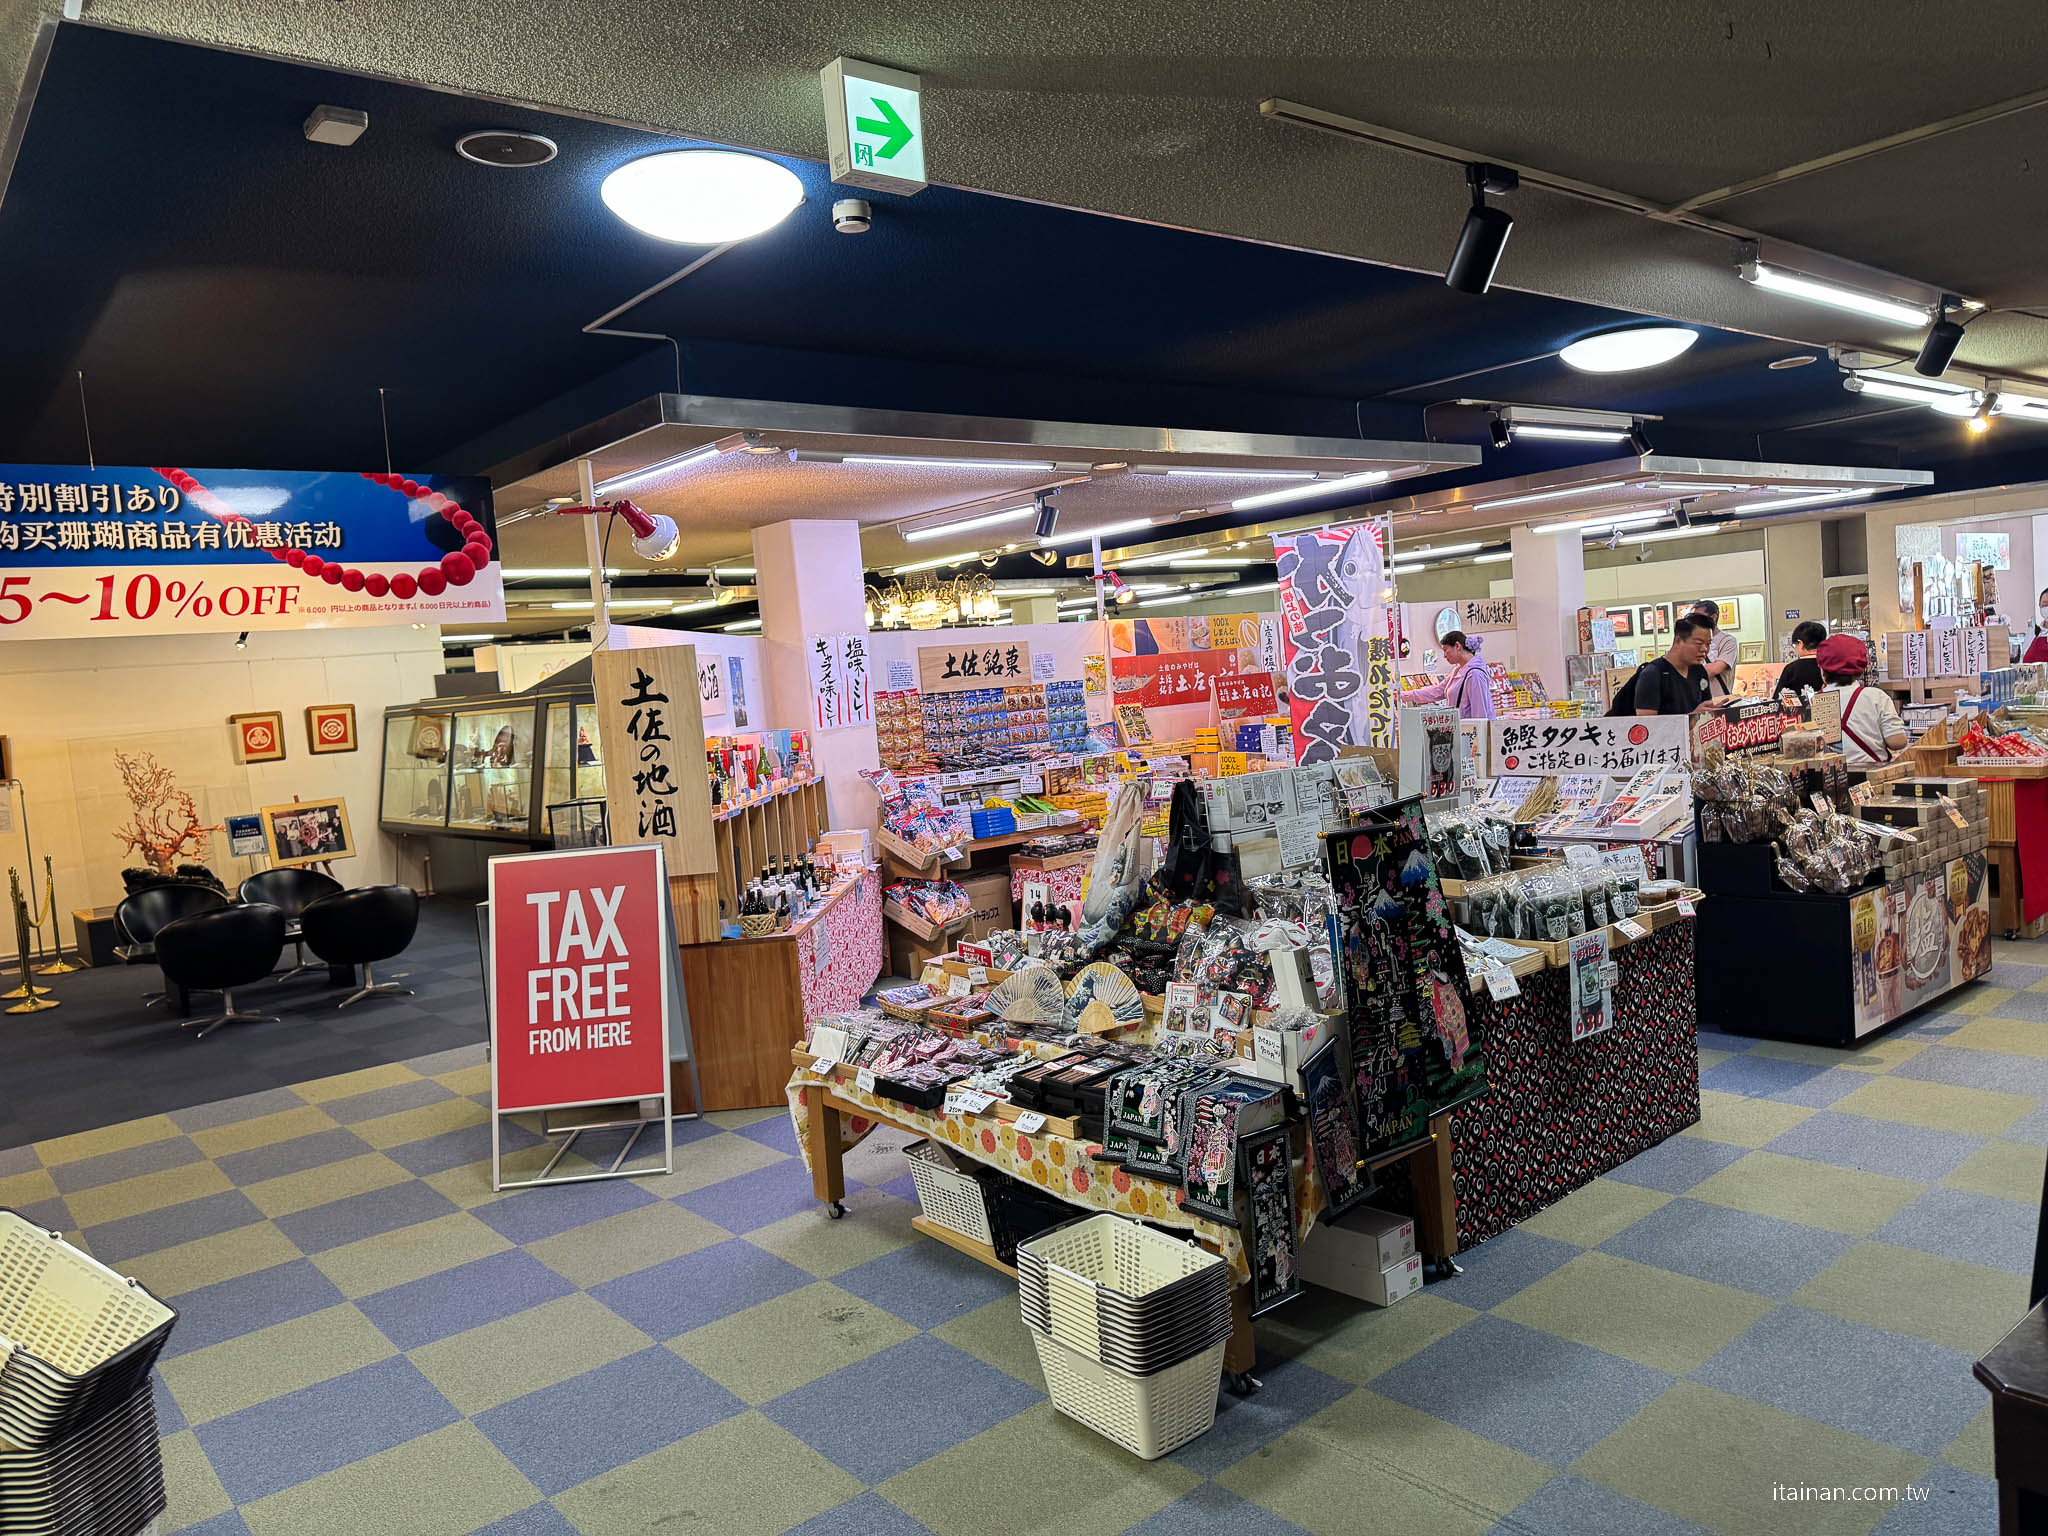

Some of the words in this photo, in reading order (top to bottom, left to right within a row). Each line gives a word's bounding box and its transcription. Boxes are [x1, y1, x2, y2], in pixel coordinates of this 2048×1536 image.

[1214, 627, 1234, 636] しまんと
[941, 645, 1023, 680] 土佐銘菓
[815, 638, 837, 727] キャラメル味ミレー
[620, 667, 679, 838] 土佐の地酒
[1030, 889, 1041, 899] 14
[526, 885, 630, 964] TAX
[528, 961, 631, 1025] FREE
[1576, 1010, 1605, 1035] 630
[529, 1026, 581, 1055] FROM
[586, 1021, 632, 1049] HERE
[1122, 1111, 1143, 1123] JAPAN
[1377, 1114, 1414, 1138] JAPAN
[1109, 1140, 1129, 1150] JAPA
[1138, 1151, 1160, 1161] JAPAN
[1196, 1192, 1222, 1206] JAPAN
